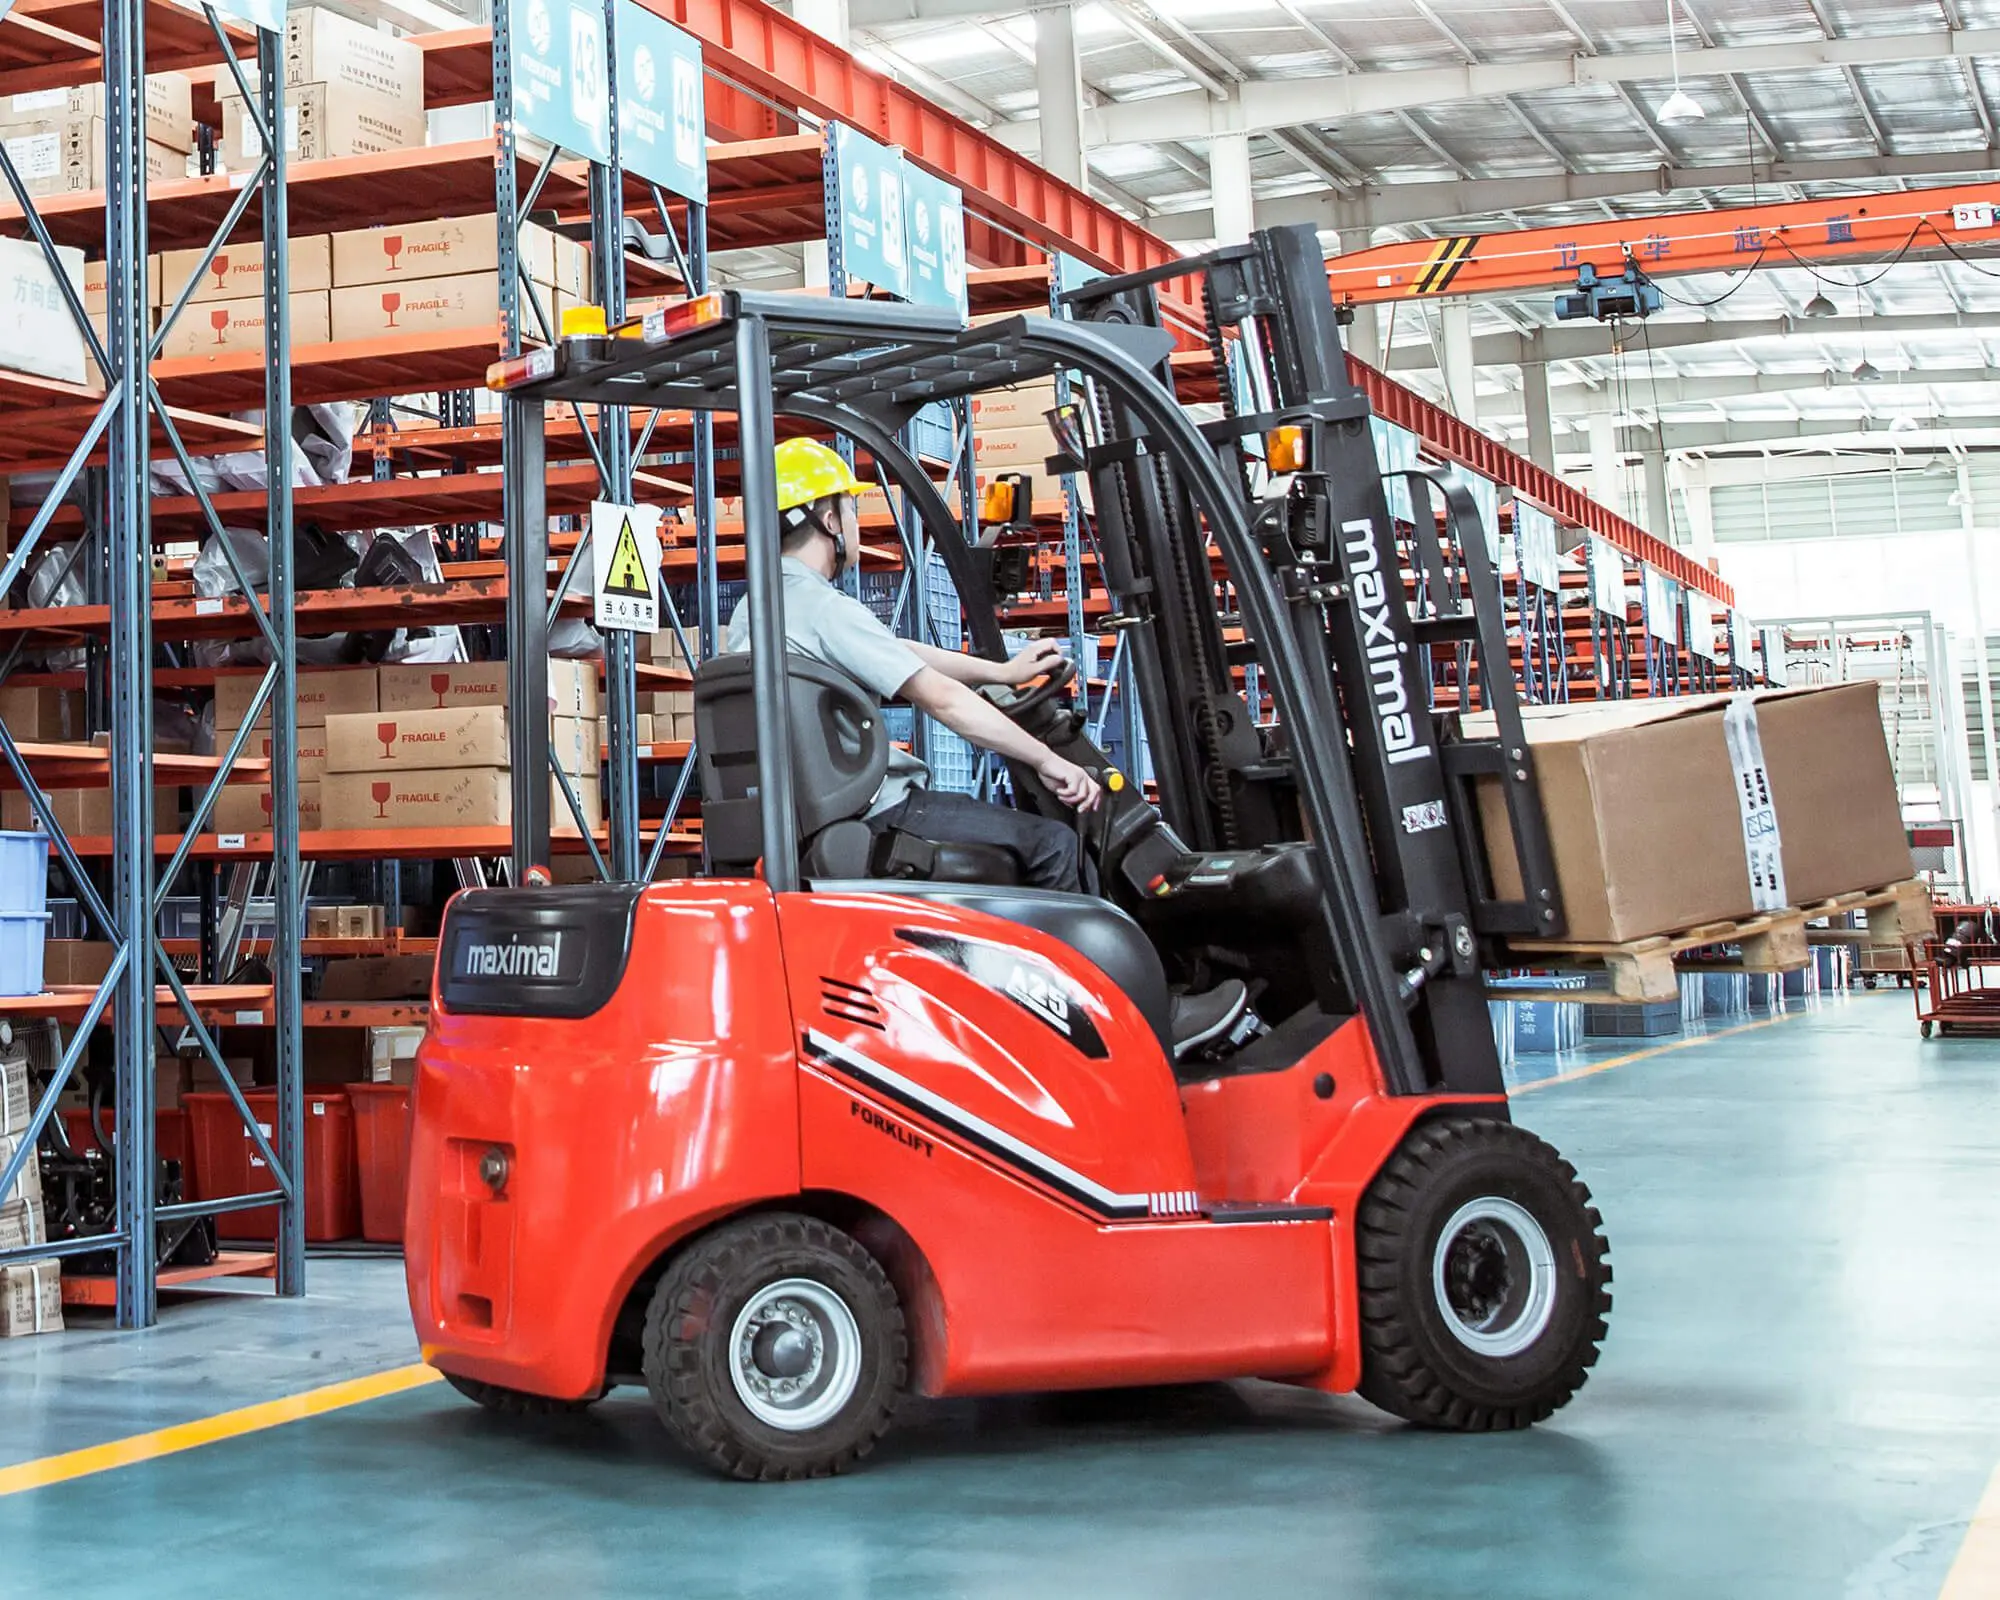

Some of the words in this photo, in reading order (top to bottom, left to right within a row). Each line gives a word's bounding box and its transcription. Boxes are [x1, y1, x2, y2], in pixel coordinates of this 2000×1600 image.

[575, 31, 597, 101] 43
[677, 77, 697, 144] 44
[407, 240, 451, 254] FRAGILE
[232, 262, 265, 275] FRAGI
[405, 298, 450, 312] FRAGILE
[232, 318, 266, 329] FRAGI
[1341, 517, 1432, 765] maximal
[454, 683, 498, 694] FRAGILE
[296, 693, 325, 703] AGILE
[401, 731, 447, 743] FRAGILE
[296, 749, 325, 758] AGILE
[395, 792, 441, 803] FRAGILE
[466, 930, 562, 976] maximal
[850, 1101, 936, 1158] FORKLIFT
